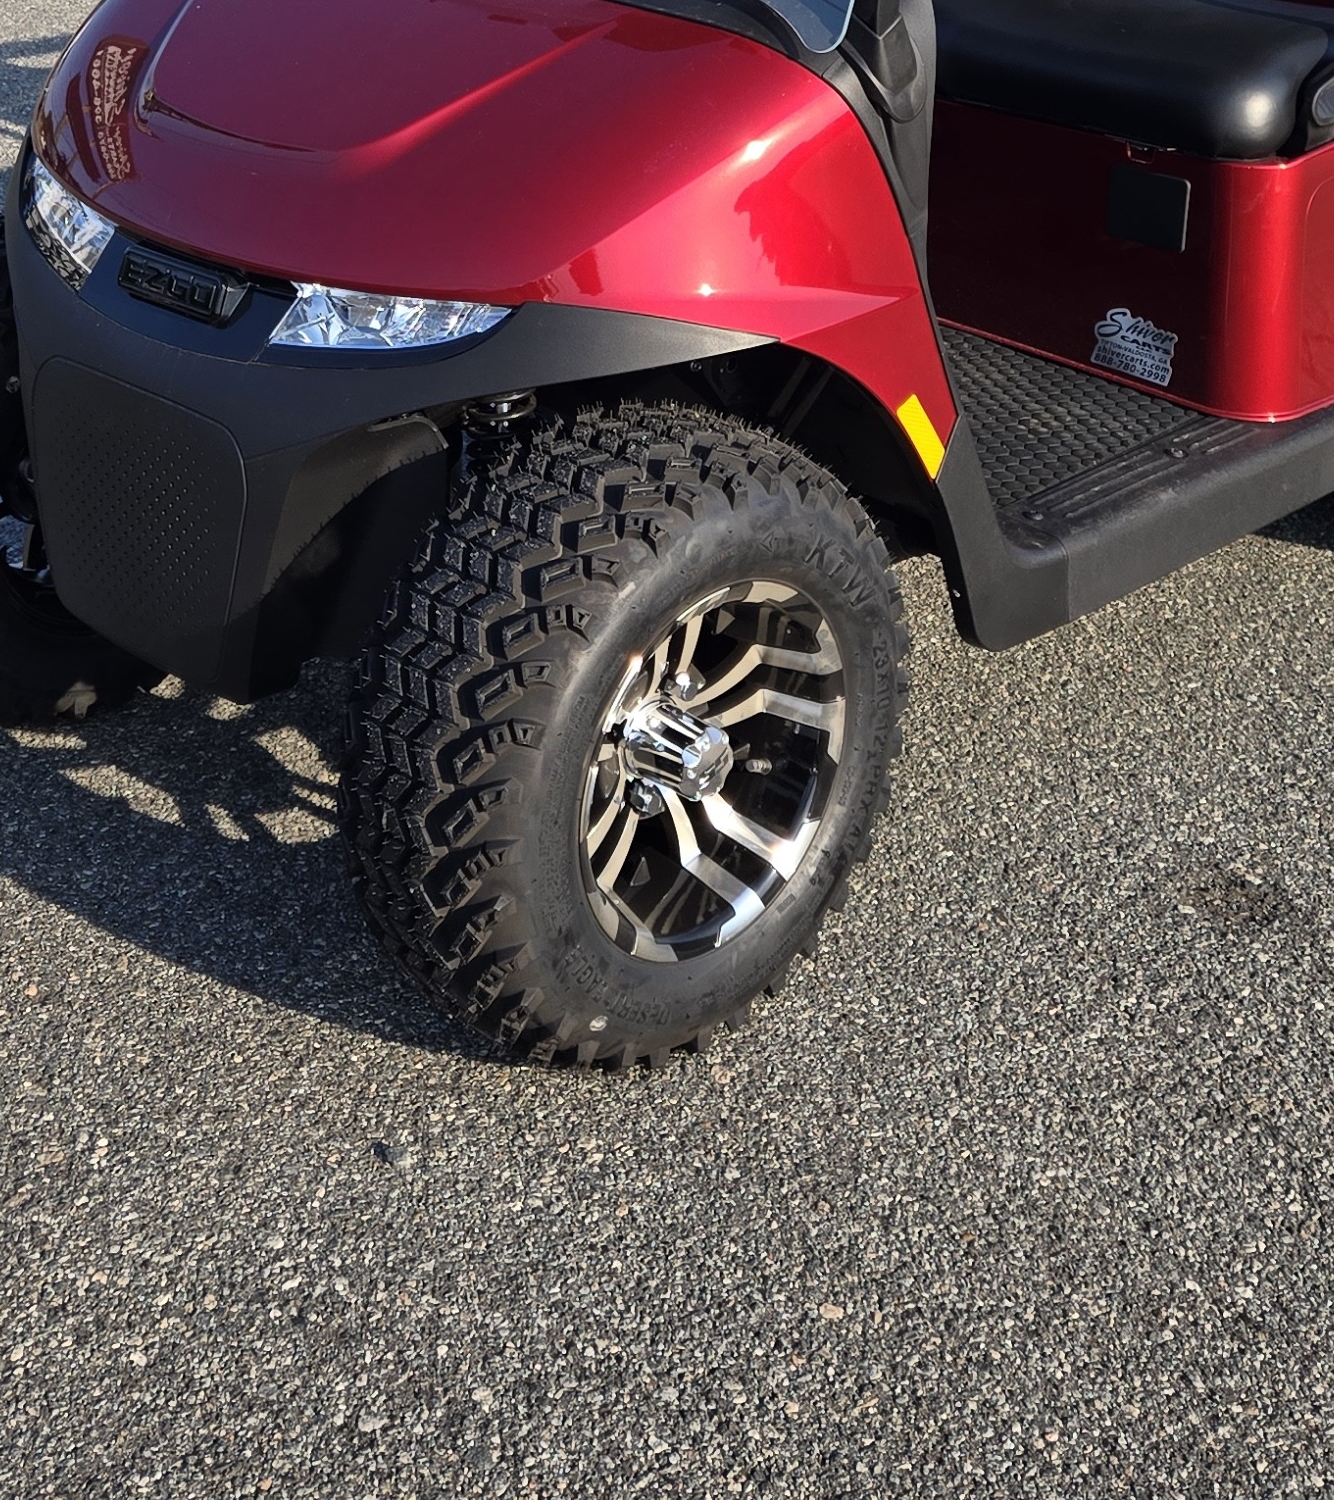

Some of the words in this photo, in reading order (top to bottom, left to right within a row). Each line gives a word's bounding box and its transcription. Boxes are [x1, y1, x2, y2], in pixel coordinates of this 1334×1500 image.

[1097, 311, 1175, 345] Shiver
[1097, 346, 1170, 375] shivercarts.com
[1120, 335, 1172, 356] CARTS
[1094, 353, 1167, 383] 888-780-2998
[804, 533, 877, 608] KTW
